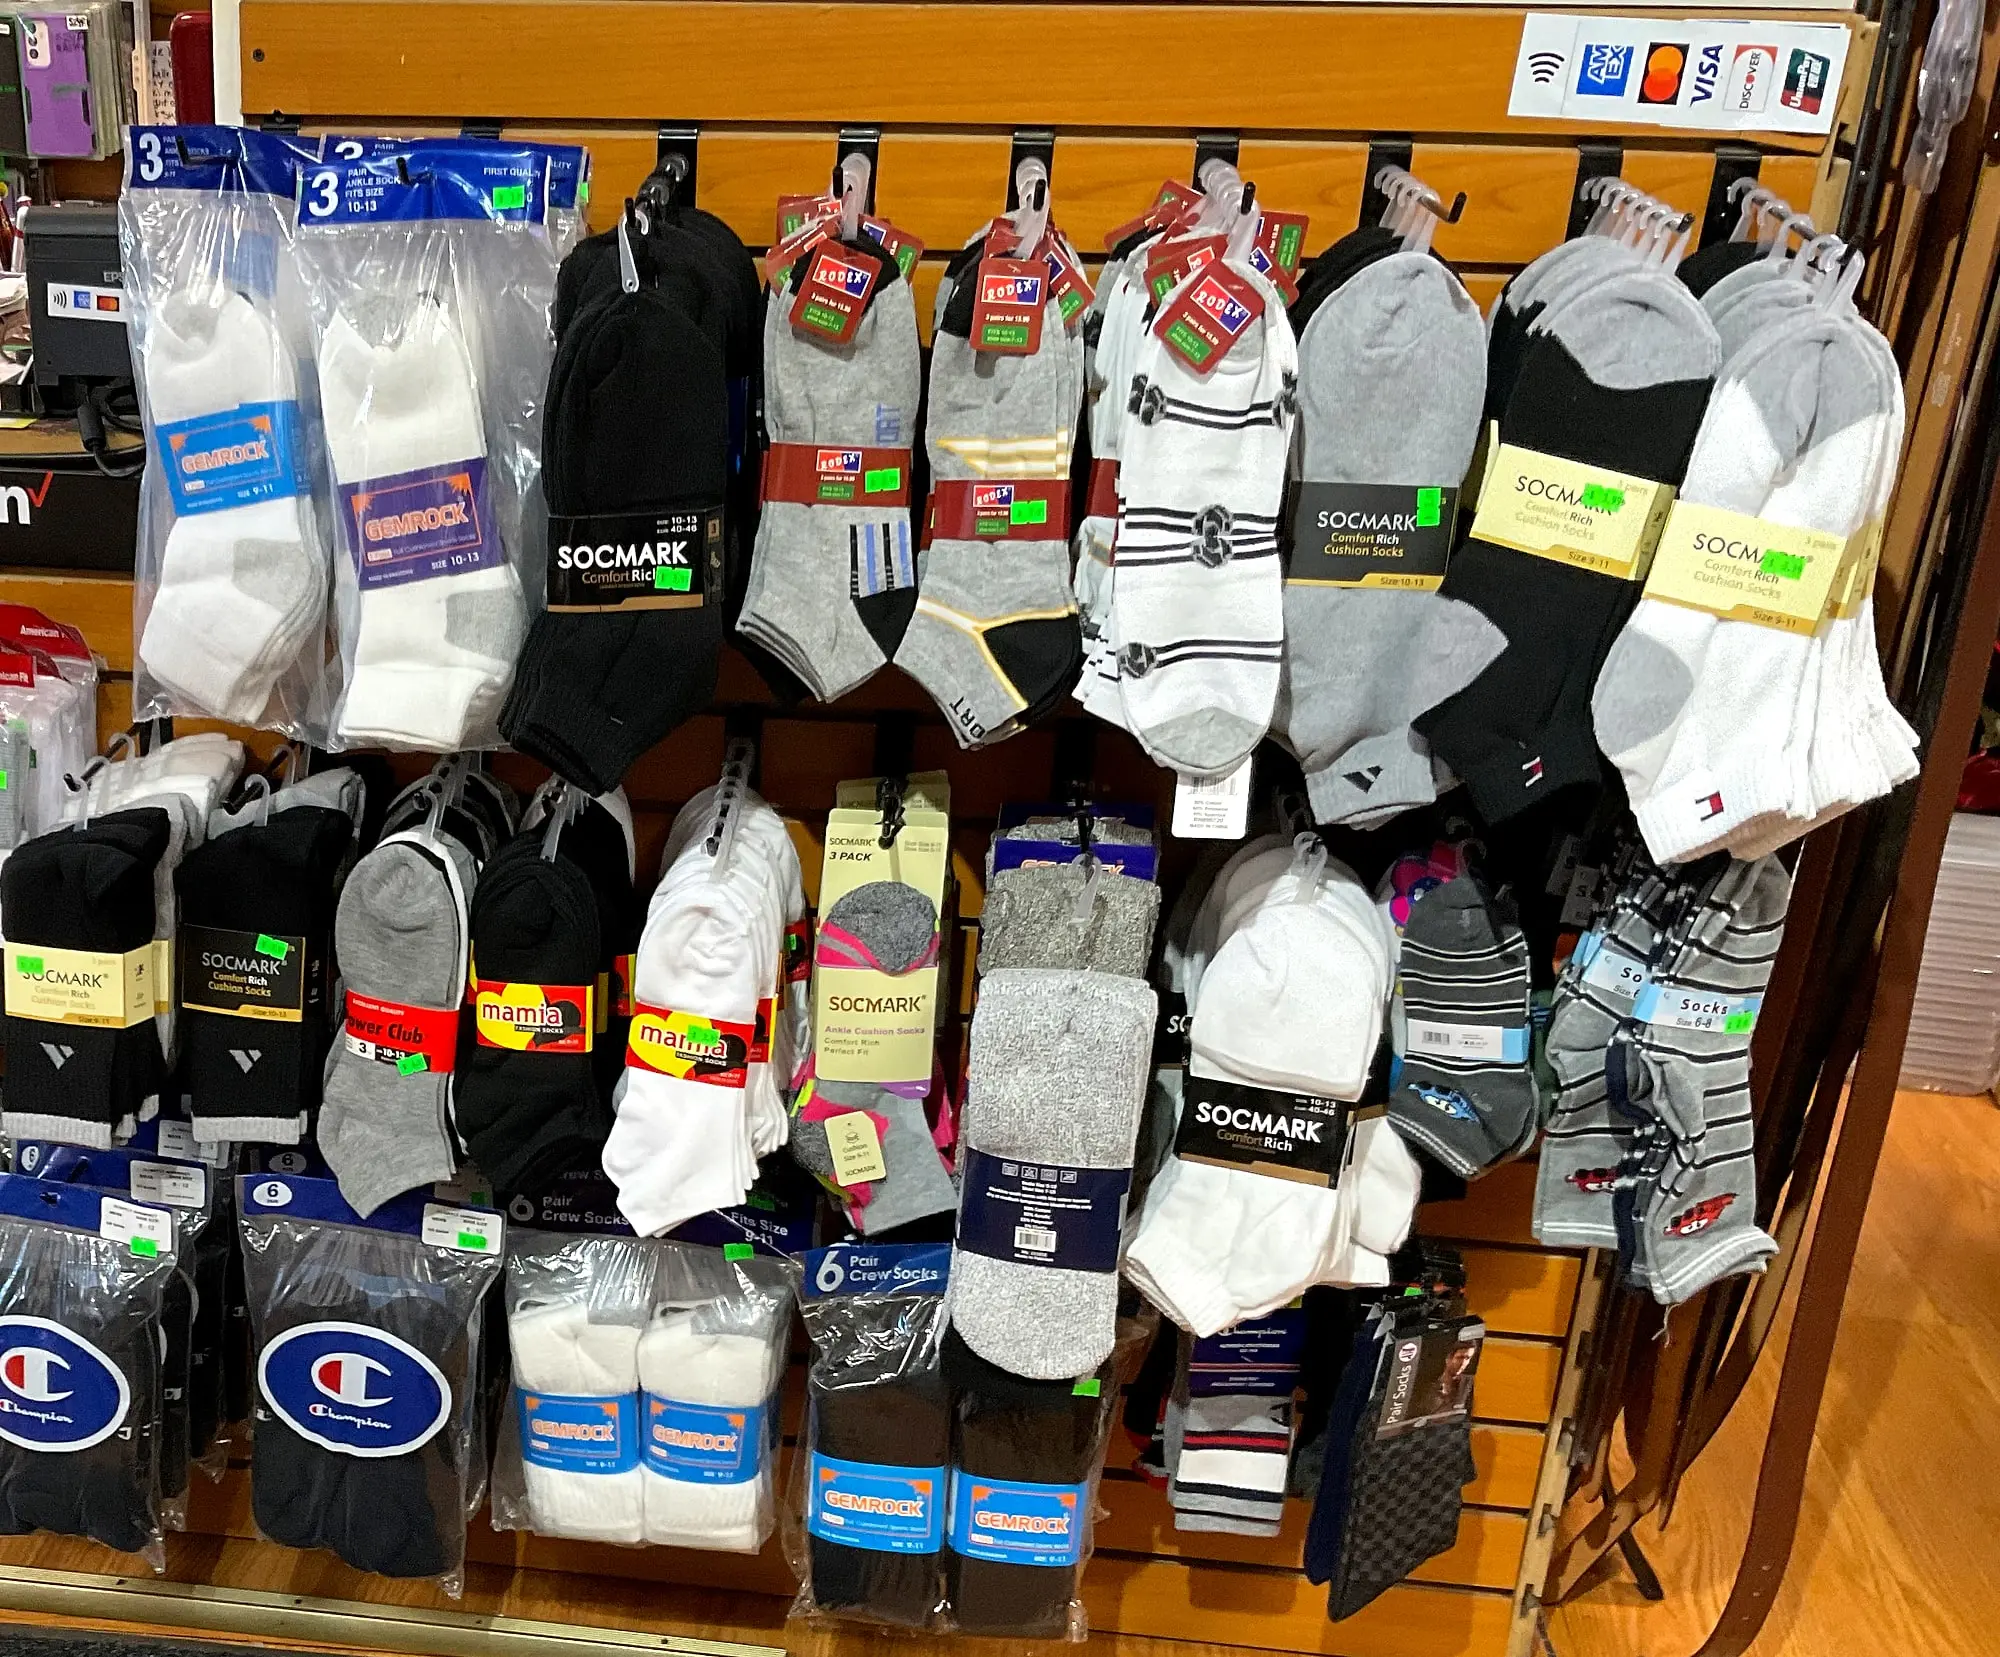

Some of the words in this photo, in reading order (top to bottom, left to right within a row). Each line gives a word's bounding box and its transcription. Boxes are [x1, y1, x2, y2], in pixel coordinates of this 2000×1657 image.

[1587, 44, 1610, 84] AM
[1605, 45, 1627, 79] EX
[1690, 44, 1724, 108] VISA
[1739, 51, 1761, 110] DISCOVER
[1789, 53, 1813, 108] UnionPay
[139, 133, 163, 181] 3
[550, 160, 572, 170] LITY
[348, 168, 367, 177] PAIR
[483, 167, 507, 176] FIRST
[345, 176, 374, 188] ANKLE
[375, 176, 400, 186] SOCK
[309, 171, 339, 217] 3
[345, 189, 362, 198] FITS
[364, 187, 384, 197] SIZE
[348, 200, 377, 212] 10-13
[819, 270, 863, 285] RODEX
[987, 279, 1032, 301] RODEX
[1199, 291, 1243, 319] RODEX
[181, 440, 269, 474] GEMROCK
[820, 453, 856, 471] RODEX
[252, 483, 273, 495] 9-11
[976, 487, 1009, 506] RODEX
[1514, 475, 1612, 516] SOCM
[365, 501, 469, 542] GEMROCK
[671, 515, 698, 525] 10-13
[1317, 511, 1417, 532] SOCMARK
[1525, 500, 1568, 519] Comfort
[1569, 513, 1593, 527] Rich
[670, 525, 698, 533] 40-46
[1515, 512, 1560, 531] Cushion
[1564, 522, 1595, 541] Socks
[1330, 532, 1375, 544] Comfort
[1376, 532, 1400, 545] Rich
[557, 541, 688, 569] SOCMARK
[1324, 544, 1369, 556] Cushion
[1372, 546, 1404, 558] Socks
[1693, 533, 1807, 564] SOCM
[431, 560, 447, 570] SIZE
[451, 552, 480, 567] 10-13
[581, 570, 631, 584] Comfort
[631, 567, 656, 583] Ric
[1704, 558, 1753, 578] Comfort
[1754, 569, 1780, 585] Rich
[1693, 570, 1744, 592] Cushion
[1747, 582, 1782, 600] Socks
[20, 624, 60, 638] American
[829, 837, 872, 847] SOCMARK
[829, 852, 836, 860] 3
[839, 852, 873, 862] PACK
[202, 952, 281, 976] SOCMARK
[213, 971, 247, 984] Comfort
[248, 975, 268, 986] Rich
[71, 990, 90, 999] Rich
[208, 981, 243, 994] Cushion
[245, 986, 272, 997] Socks
[1613, 984, 1631, 996] Size
[31, 995, 67, 1006] Cushion
[69, 999, 96, 1010] Socks
[828, 996, 921, 1013] SOCMARK
[1680, 998, 1729, 1015] Socks
[482, 1003, 561, 1024] mamia
[1675, 1017, 1693, 1026] Size
[1694, 1016, 1713, 1028] 6-8
[347, 1015, 383, 1035] ower
[388, 1023, 423, 1044] Club
[824, 1026, 852, 1034] Ankle
[854, 1026, 895, 1036] Cushion
[896, 1027, 925, 1035] Socks
[824, 1037, 859, 1046] Comfort
[861, 1038, 880, 1046] Rich
[359, 1042, 367, 1054] 3
[383, 1048, 405, 1059] 10-13
[824, 1047, 855, 1056] Perfect
[857, 1048, 869, 1056] Fit
[704, 1058, 727, 1067] SOCKS
[1307, 1106, 1335, 1116] 40-46
[1310, 1098, 1337, 1109] 10-13
[1195, 1101, 1324, 1144] SOCMARK
[843, 1143, 868, 1153] Cushion
[1216, 1128, 1264, 1146] Comfort
[1264, 1137, 1293, 1152] Rich
[281, 1153, 294, 1166] 6
[844, 1154, 857, 1162] Size
[845, 1164, 877, 1176] SOCMARK
[267, 1183, 279, 1198] 6
[509, 1193, 535, 1221] 6
[542, 1195, 573, 1209] Pair
[542, 1210, 580, 1224] Crew
[584, 1211, 630, 1226] Socks
[730, 1211, 757, 1227] Fits
[759, 1220, 789, 1237] Size
[744, 1231, 774, 1246] 9-11
[850, 1256, 880, 1267] Pair
[816, 1250, 845, 1293] 6
[850, 1269, 892, 1281] Crew
[893, 1267, 938, 1280] Socks
[1218, 1326, 1288, 1339] Champion
[1394, 1364, 1412, 1399] Socks
[1386, 1392, 1403, 1423] Pair
[308, 1403, 392, 1430] Champion
[531, 1418, 615, 1442] GEMROCK
[652, 1425, 737, 1451] GEMROCK
[825, 1489, 925, 1518] GEMROCK
[975, 1510, 1070, 1535] GEMROCK
